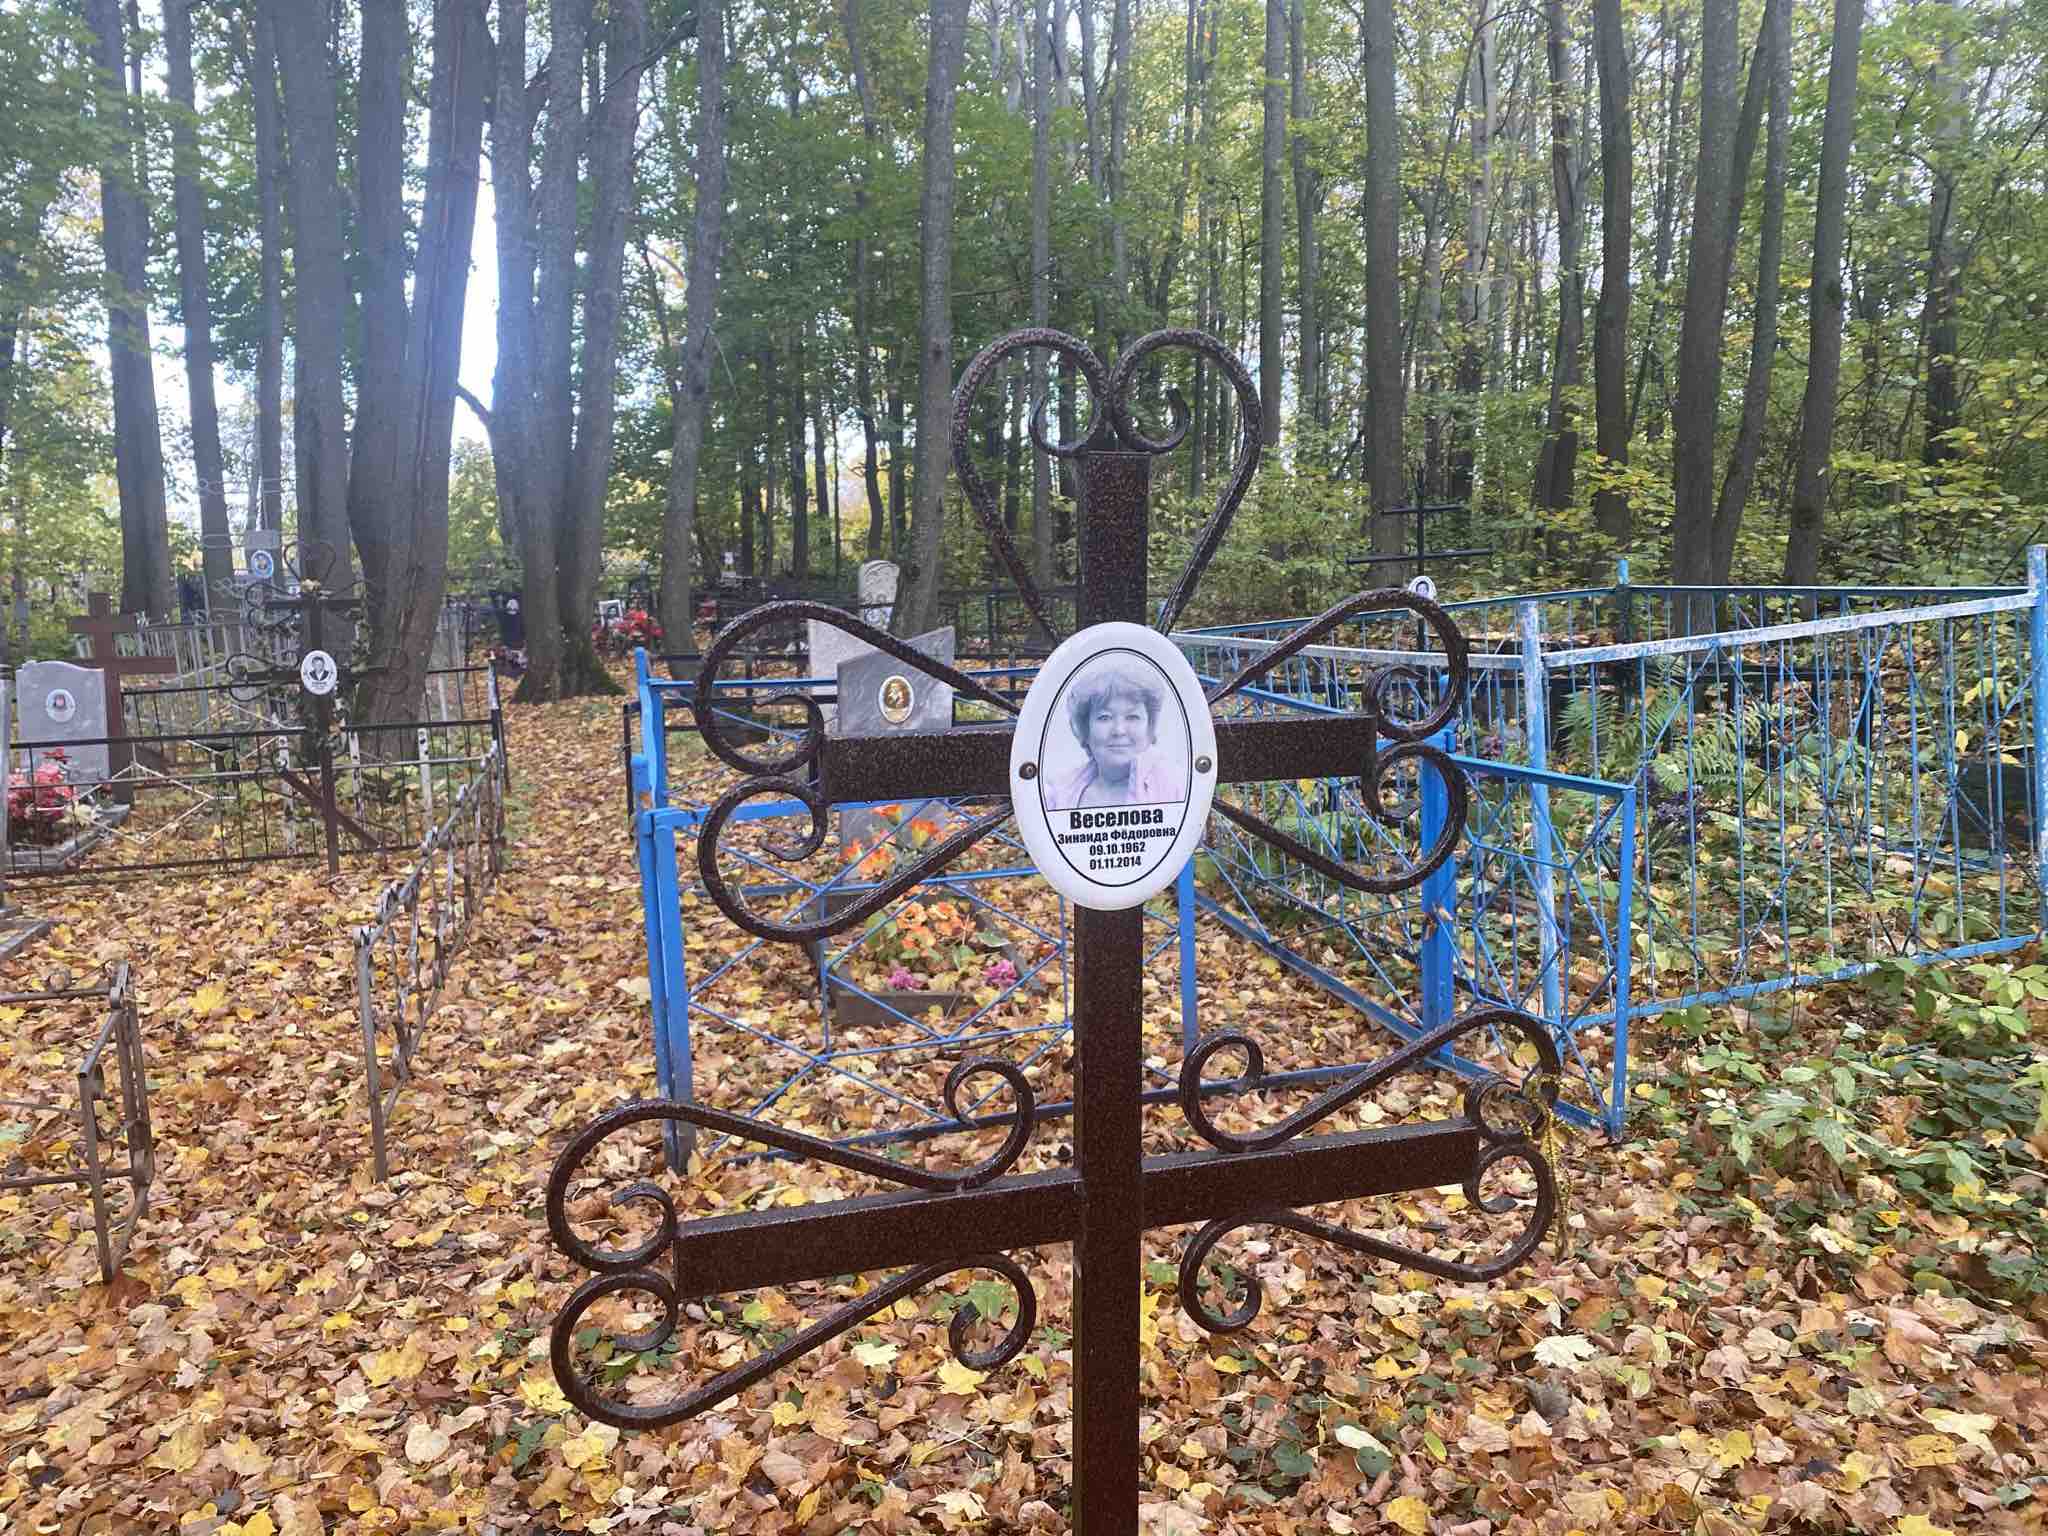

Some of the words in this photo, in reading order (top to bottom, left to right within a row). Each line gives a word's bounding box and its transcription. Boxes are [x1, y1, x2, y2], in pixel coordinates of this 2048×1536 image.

[1070, 809, 1164, 829] Веселова
[1058, 832, 1109, 845] Зинаида
[1089, 841, 1146, 856] 09.10.1962
[1089, 856, 1142, 870] 01.11.2014
